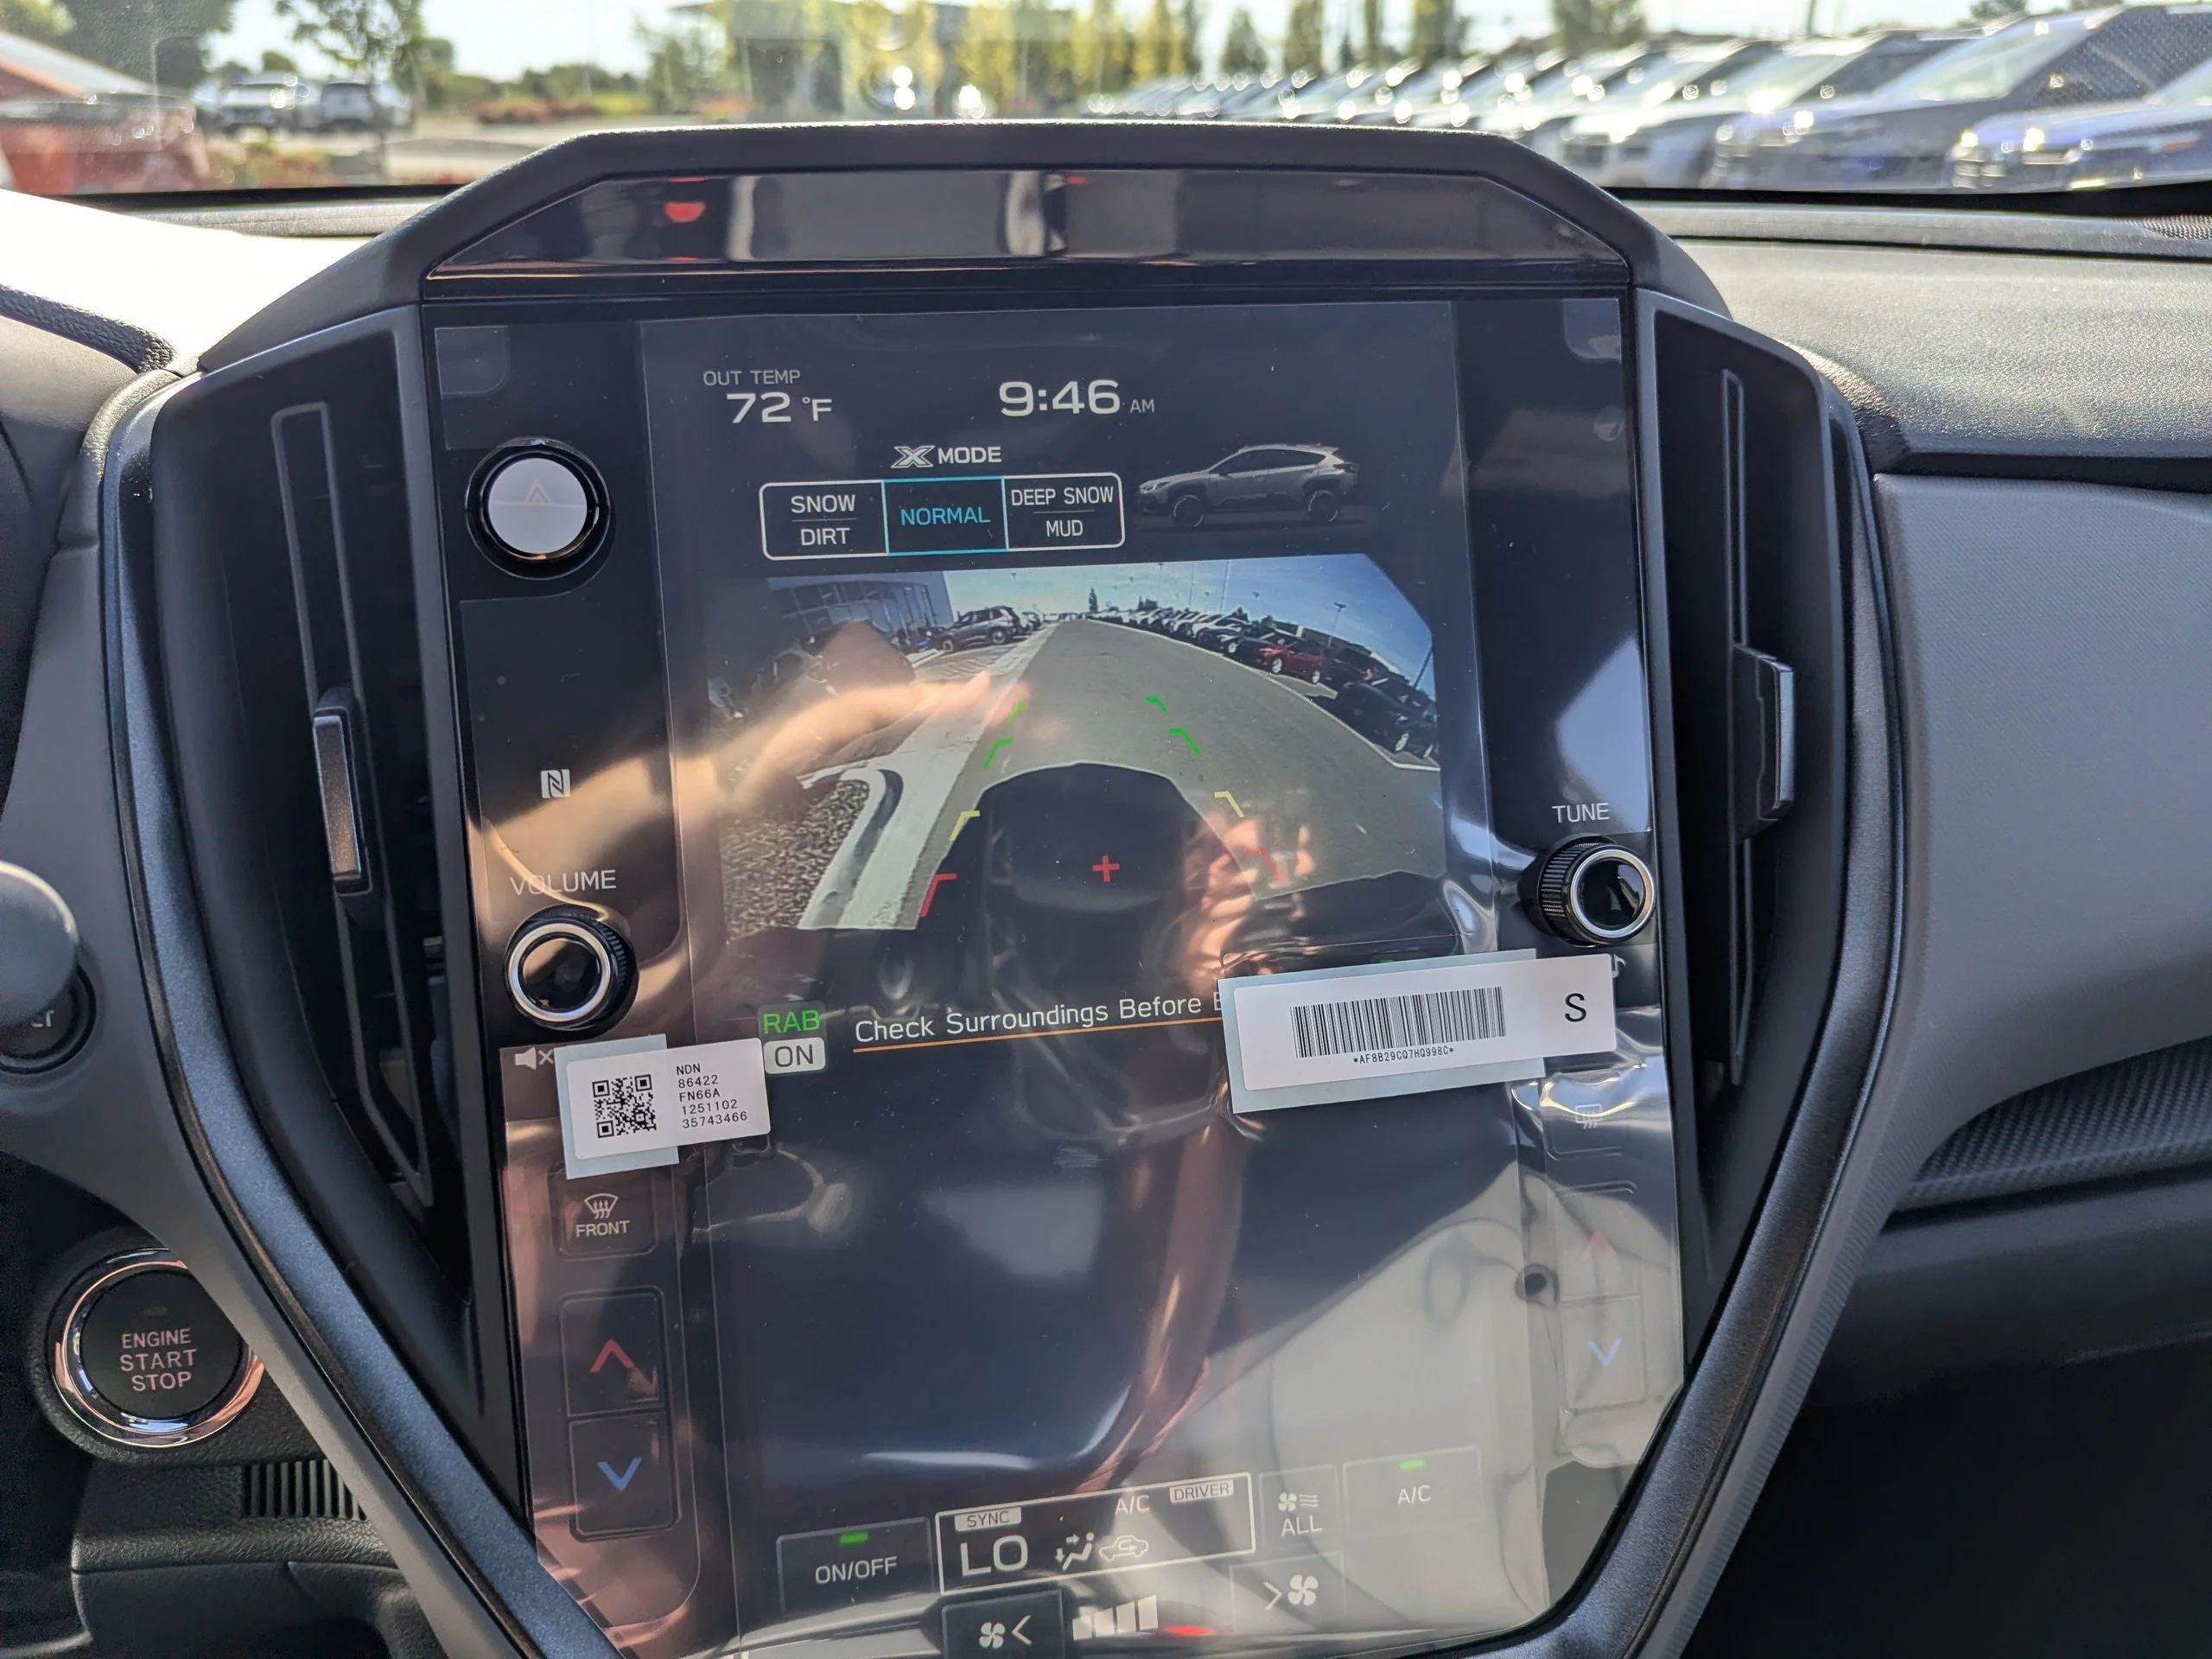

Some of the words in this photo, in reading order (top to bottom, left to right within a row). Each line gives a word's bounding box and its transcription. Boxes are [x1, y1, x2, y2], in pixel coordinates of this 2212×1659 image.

[702, 371, 741, 386] OUT
[750, 370, 801, 385] TEMP
[726, 391, 791, 423] 72
[999, 379, 1121, 416] 9:46
[1129, 398, 1155, 414] AM
[938, 446, 1001, 465] MODE
[791, 494, 856, 513] SNOW
[1011, 488, 1056, 506] DEEP
[1064, 486, 1114, 505] SNOW
[900, 506, 991, 525] NORMAL
[800, 527, 850, 546] DIRT
[1046, 520, 1084, 537] MUD
[1551, 803, 1611, 823] TUNE
[510, 869, 617, 896] VOLUME
[1564, 993, 1586, 1022] S
[763, 1009, 820, 1035] RAB
[855, 1016, 935, 1043] Check
[946, 1004, 1109, 1035] Surroundings
[1119, 995, 1202, 1020] Before
[774, 1044, 814, 1068] ON
[676, 1063, 701, 1076] NDN
[677, 1074, 719, 1089] 86422
[679, 1088, 721, 1102] FN66A
[682, 1099, 738, 1116] 1251102
[683, 1111, 747, 1129] 35743466
[575, 1219, 630, 1237] FRONT
[121, 1328, 192, 1349] ENGINE
[120, 1349, 198, 1372] START
[131, 1371, 192, 1392] STOP
[1173, 1482, 1230, 1502] DRIVER
[1397, 1484, 1433, 1506] A/C
[1114, 1494, 1150, 1516] A/C
[966, 1510, 1010, 1528] SYNC
[1281, 1516, 1323, 1537] ALL
[960, 1535, 1028, 1577] LO
[815, 1556, 899, 1584] ON/OFF
